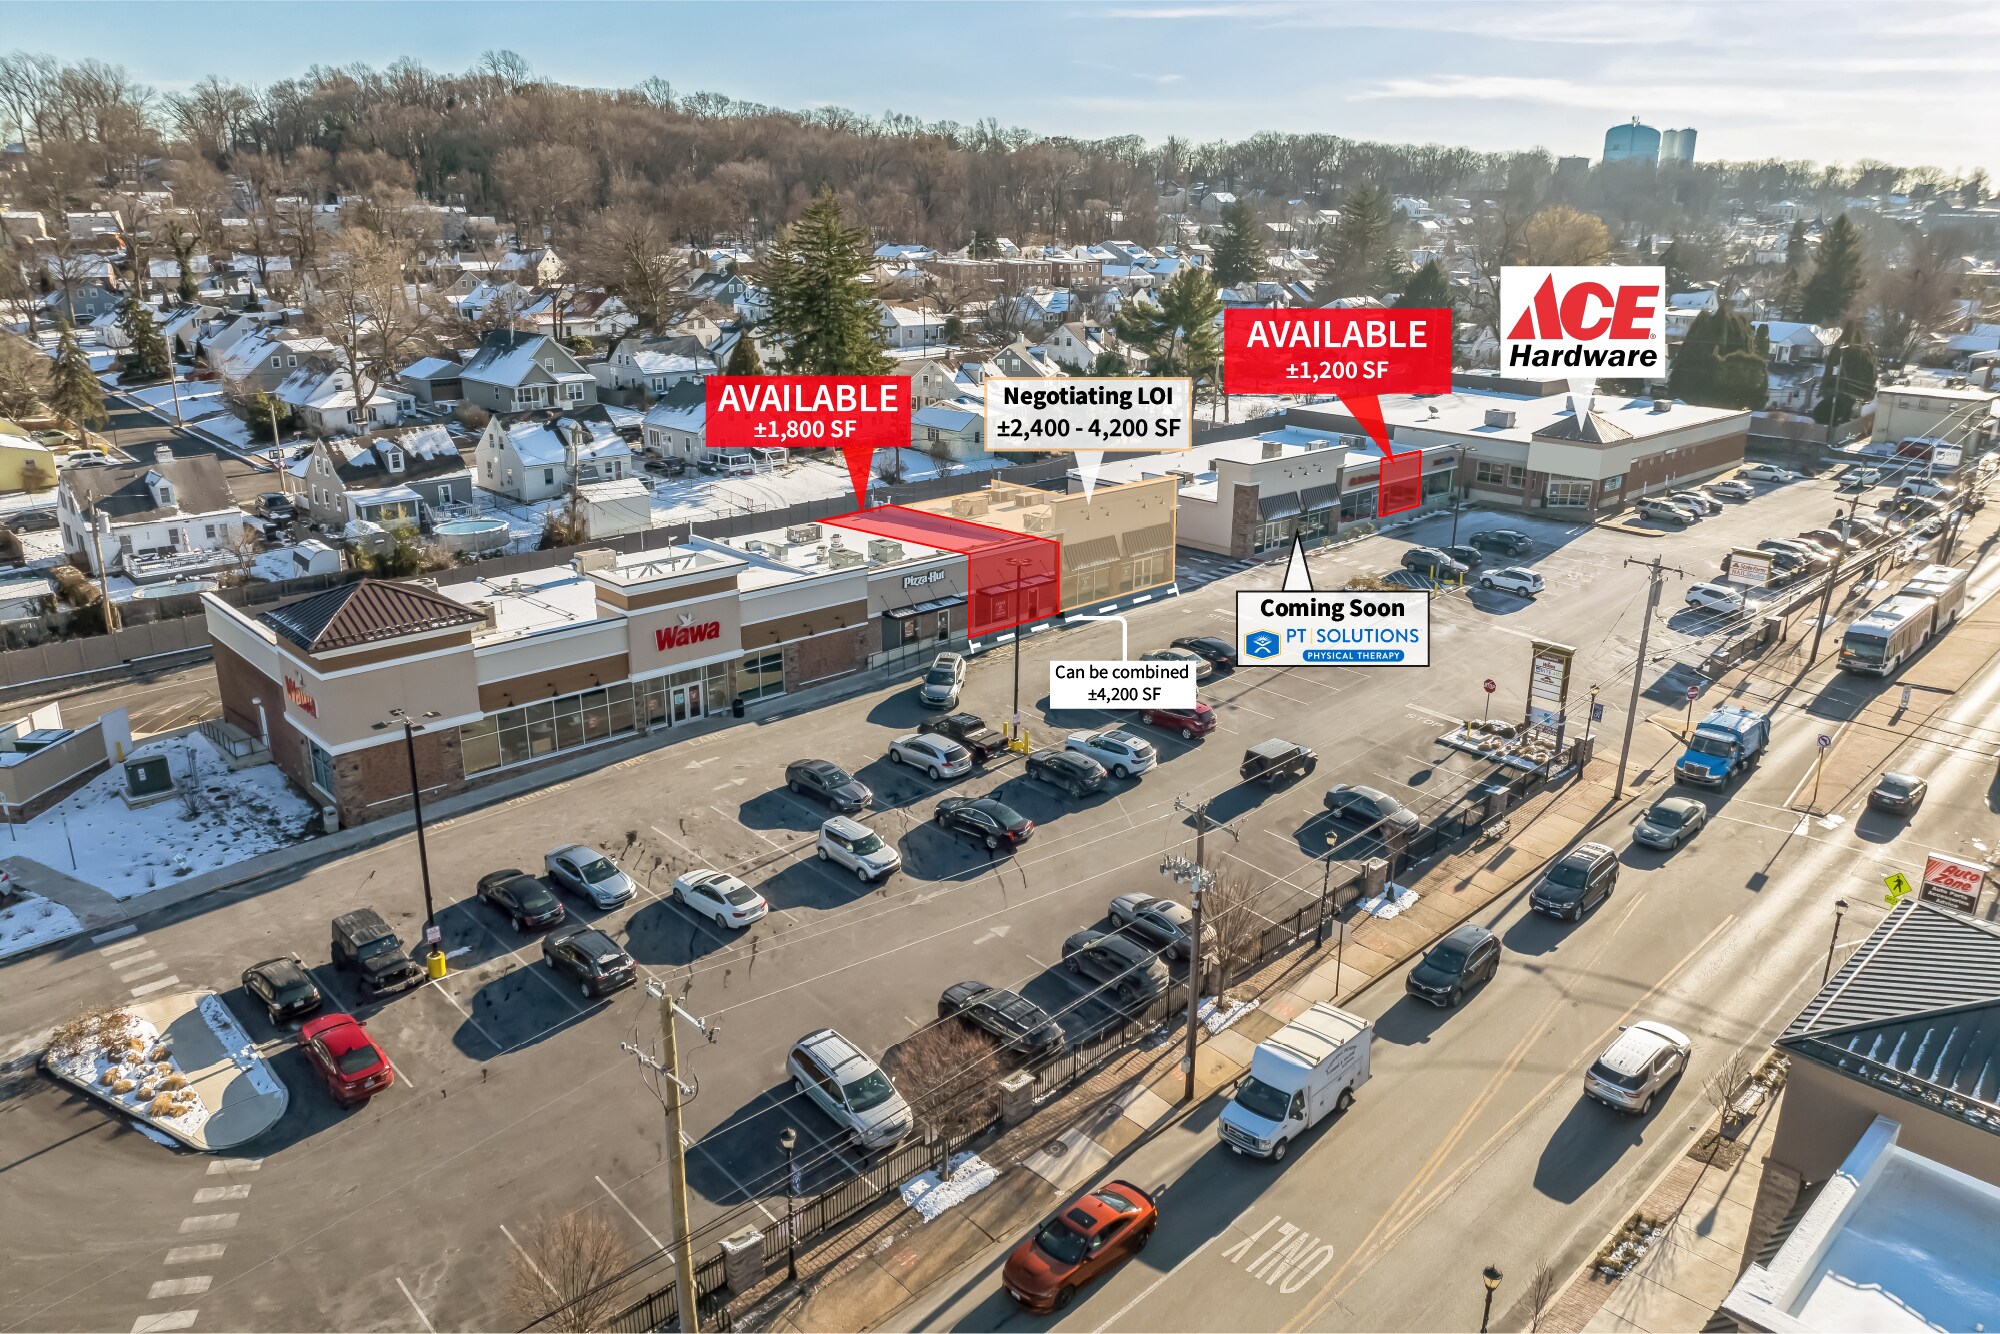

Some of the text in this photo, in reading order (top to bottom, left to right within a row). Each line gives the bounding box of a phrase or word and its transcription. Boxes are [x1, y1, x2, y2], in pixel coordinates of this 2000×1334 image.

[903, 570, 945, 589] Pizza Hut
[656, 620, 720, 652] Wawa
[614, 755, 650, 771] FIRE
[688, 731, 727, 747] LANE
[1931, 873, 1972, 891] Zone
[1941, 865, 1980, 882] Auto
[1221, 1215, 1334, 1294] ONLY
